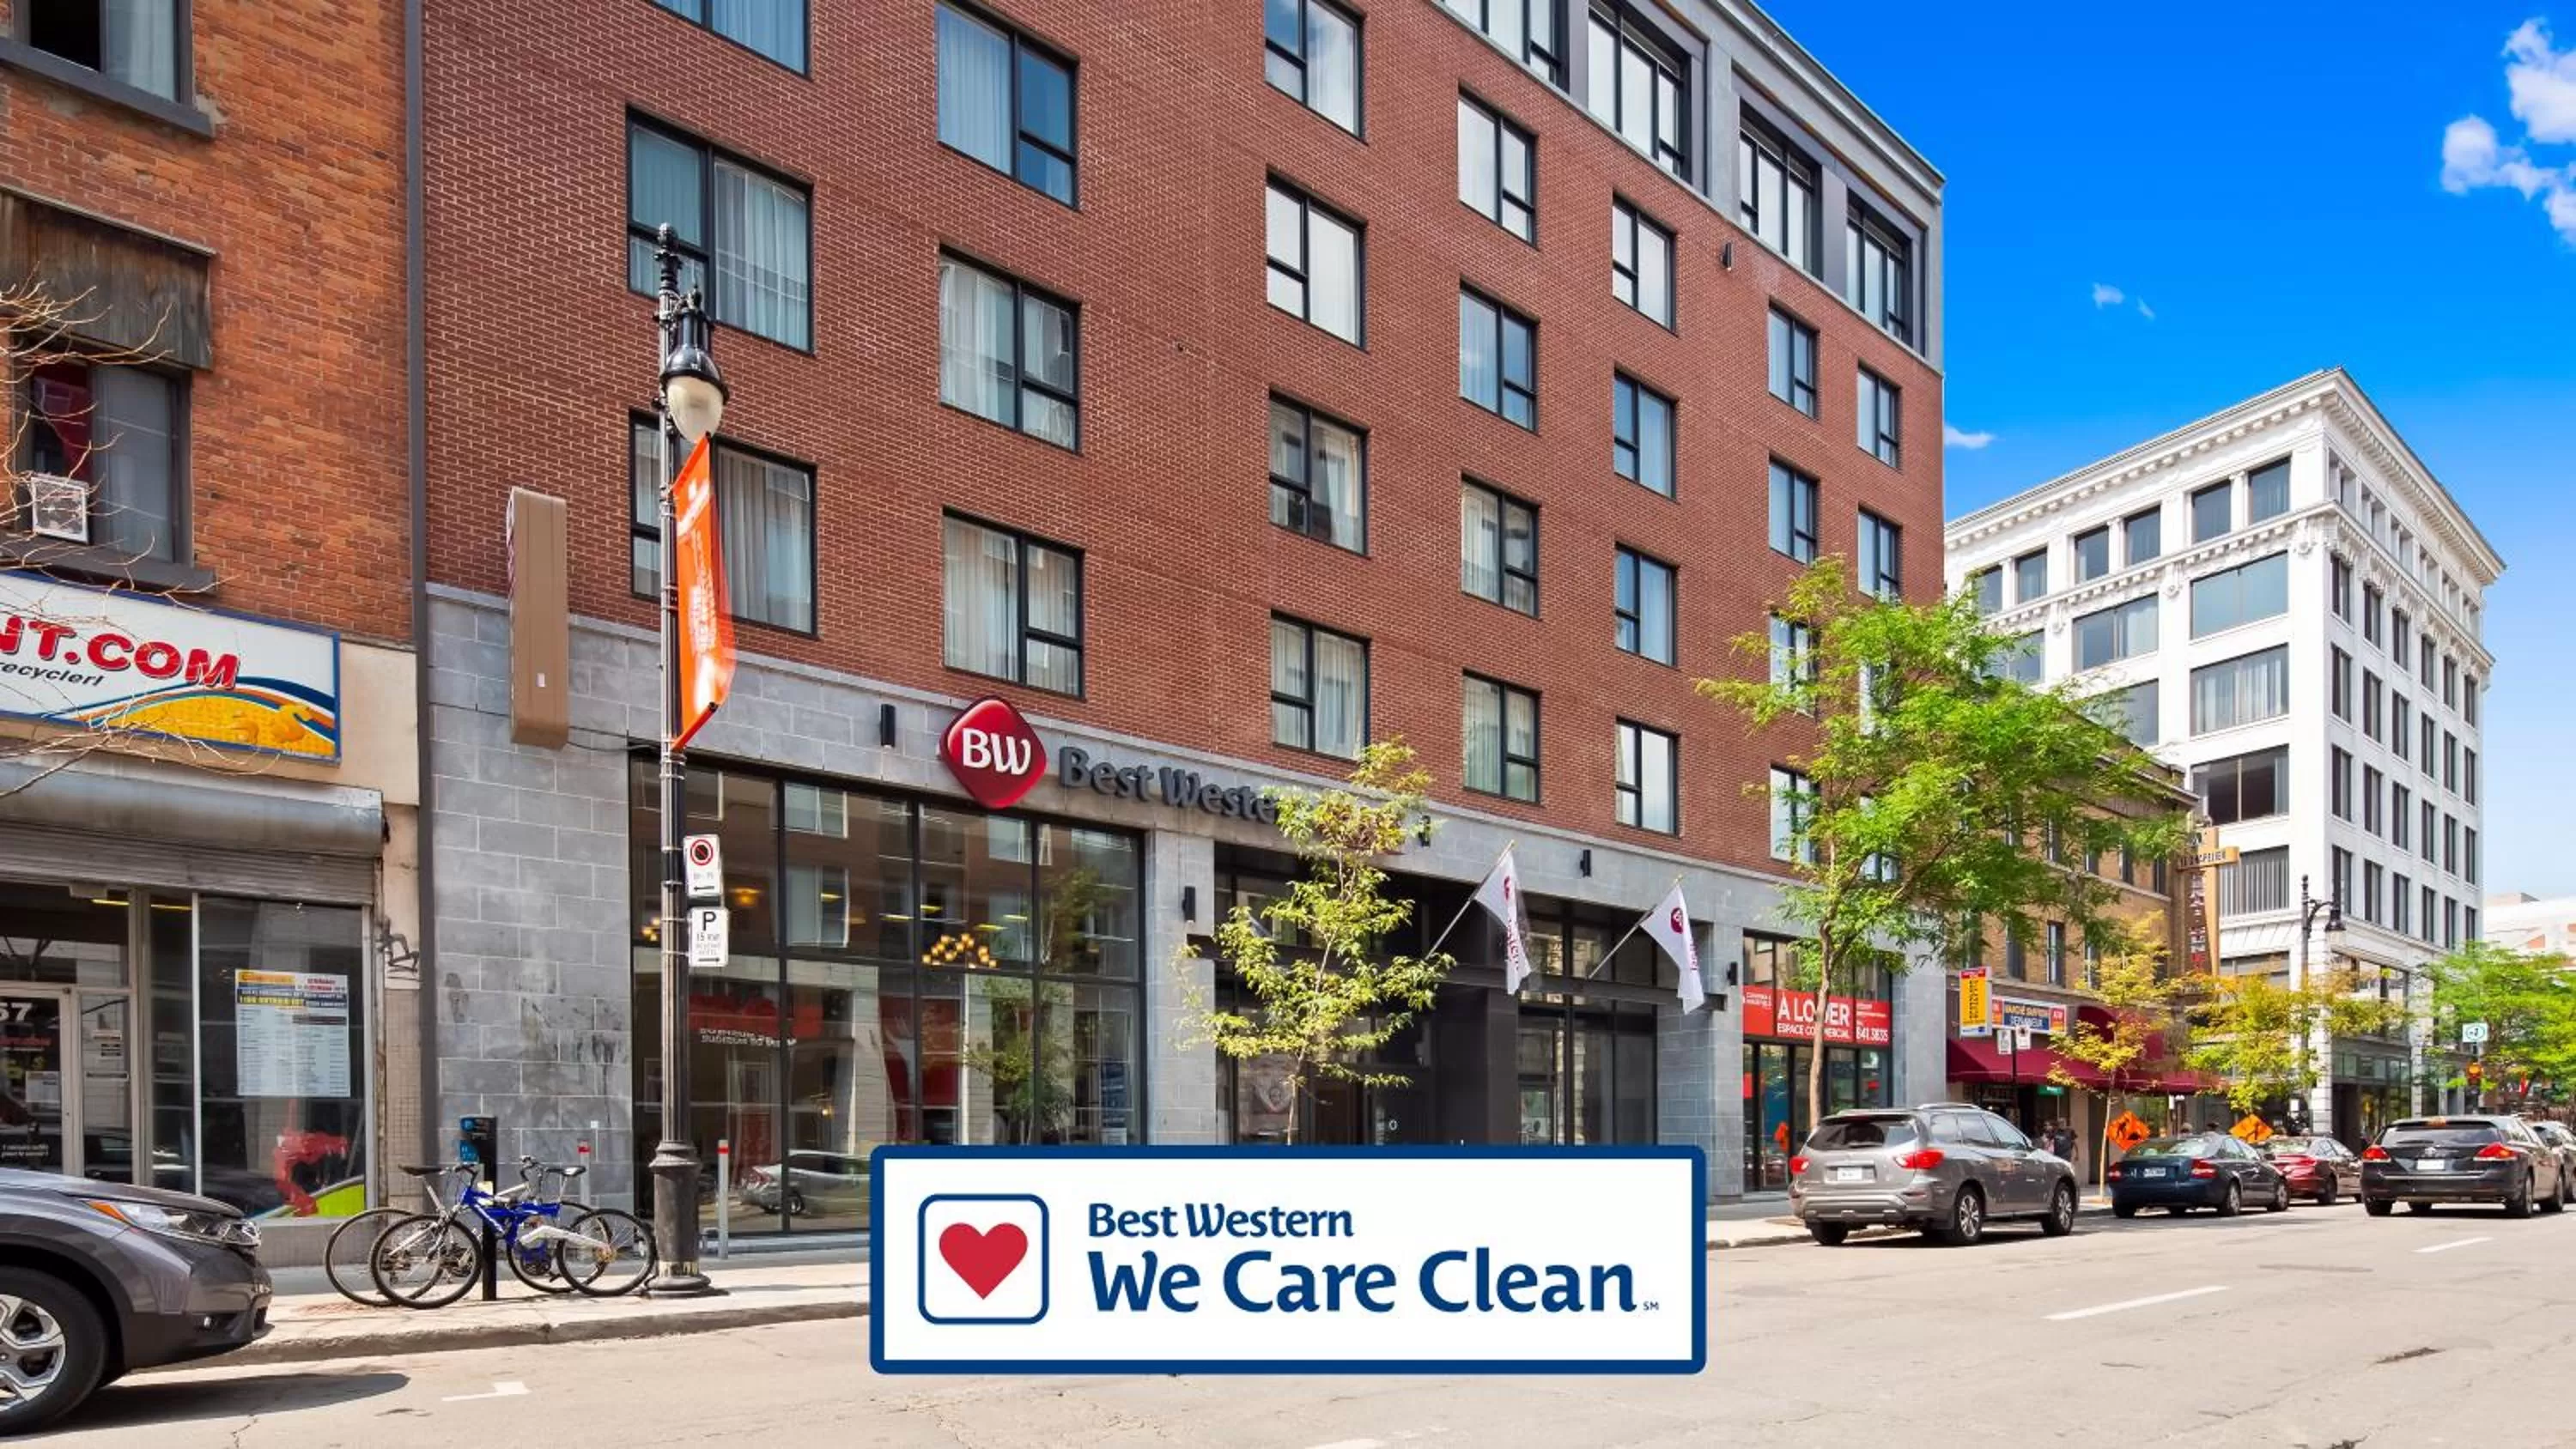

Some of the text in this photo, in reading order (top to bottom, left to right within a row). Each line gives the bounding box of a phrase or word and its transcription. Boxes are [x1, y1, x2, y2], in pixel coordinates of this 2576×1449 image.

[961, 726, 1032, 776] BW
[1058, 745, 1278, 825] Best Weste
[702, 911, 716, 931] P
[1794, 997, 1850, 1028] LOER
